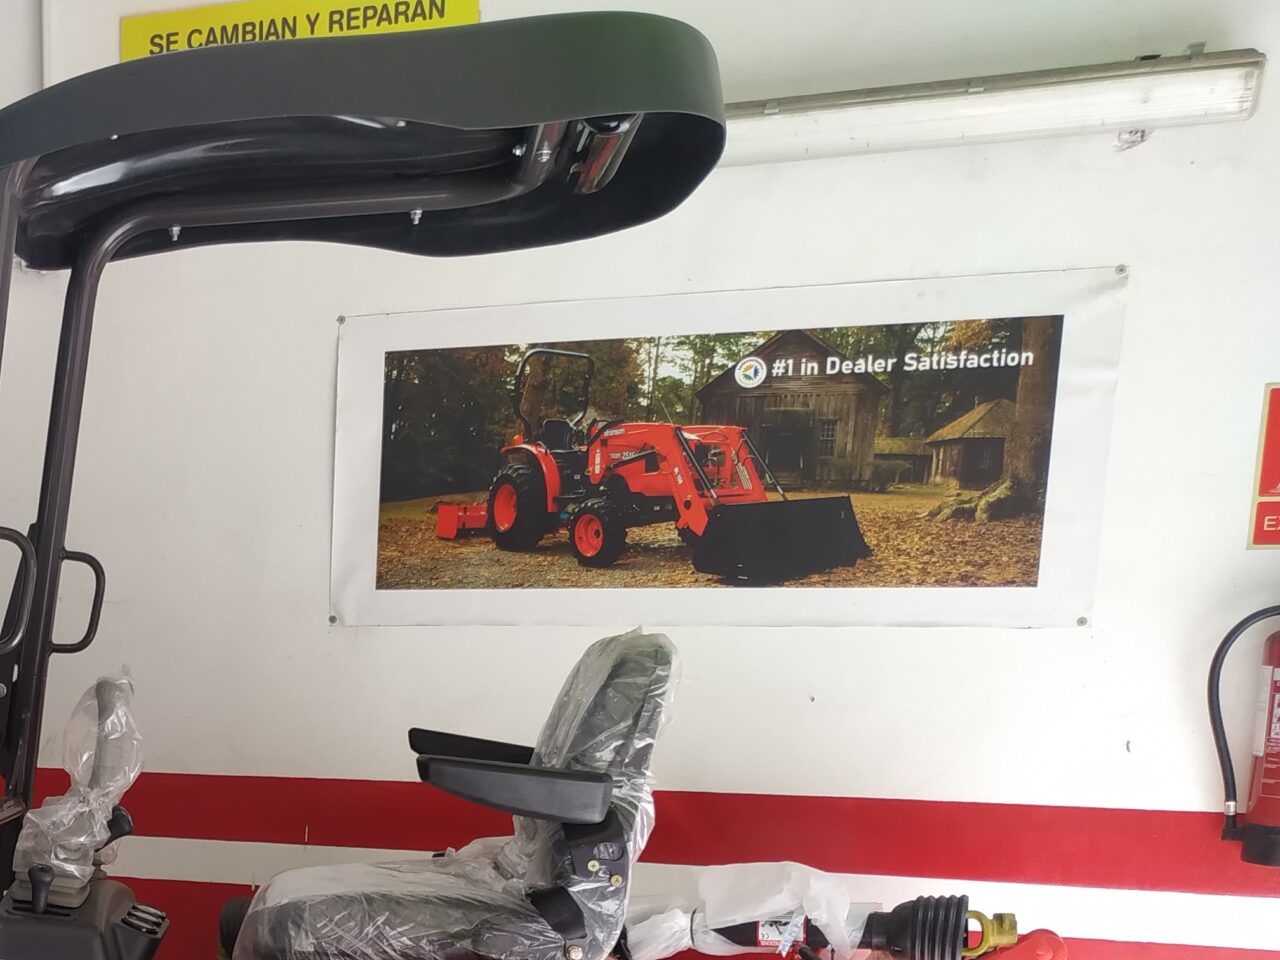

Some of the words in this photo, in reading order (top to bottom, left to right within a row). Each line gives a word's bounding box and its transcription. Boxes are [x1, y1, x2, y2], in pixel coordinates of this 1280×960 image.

[149, 31, 179, 56] SE
[187, 16, 297, 50] CAMBIAN
[307, 12, 320, 36] Y
[327, 0, 446, 33] REPARAN
[772, 358, 794, 377] #1
[800, 358, 819, 376] in
[826, 355, 898, 375] Dealer
[903, 348, 1034, 372] Satisfaction
